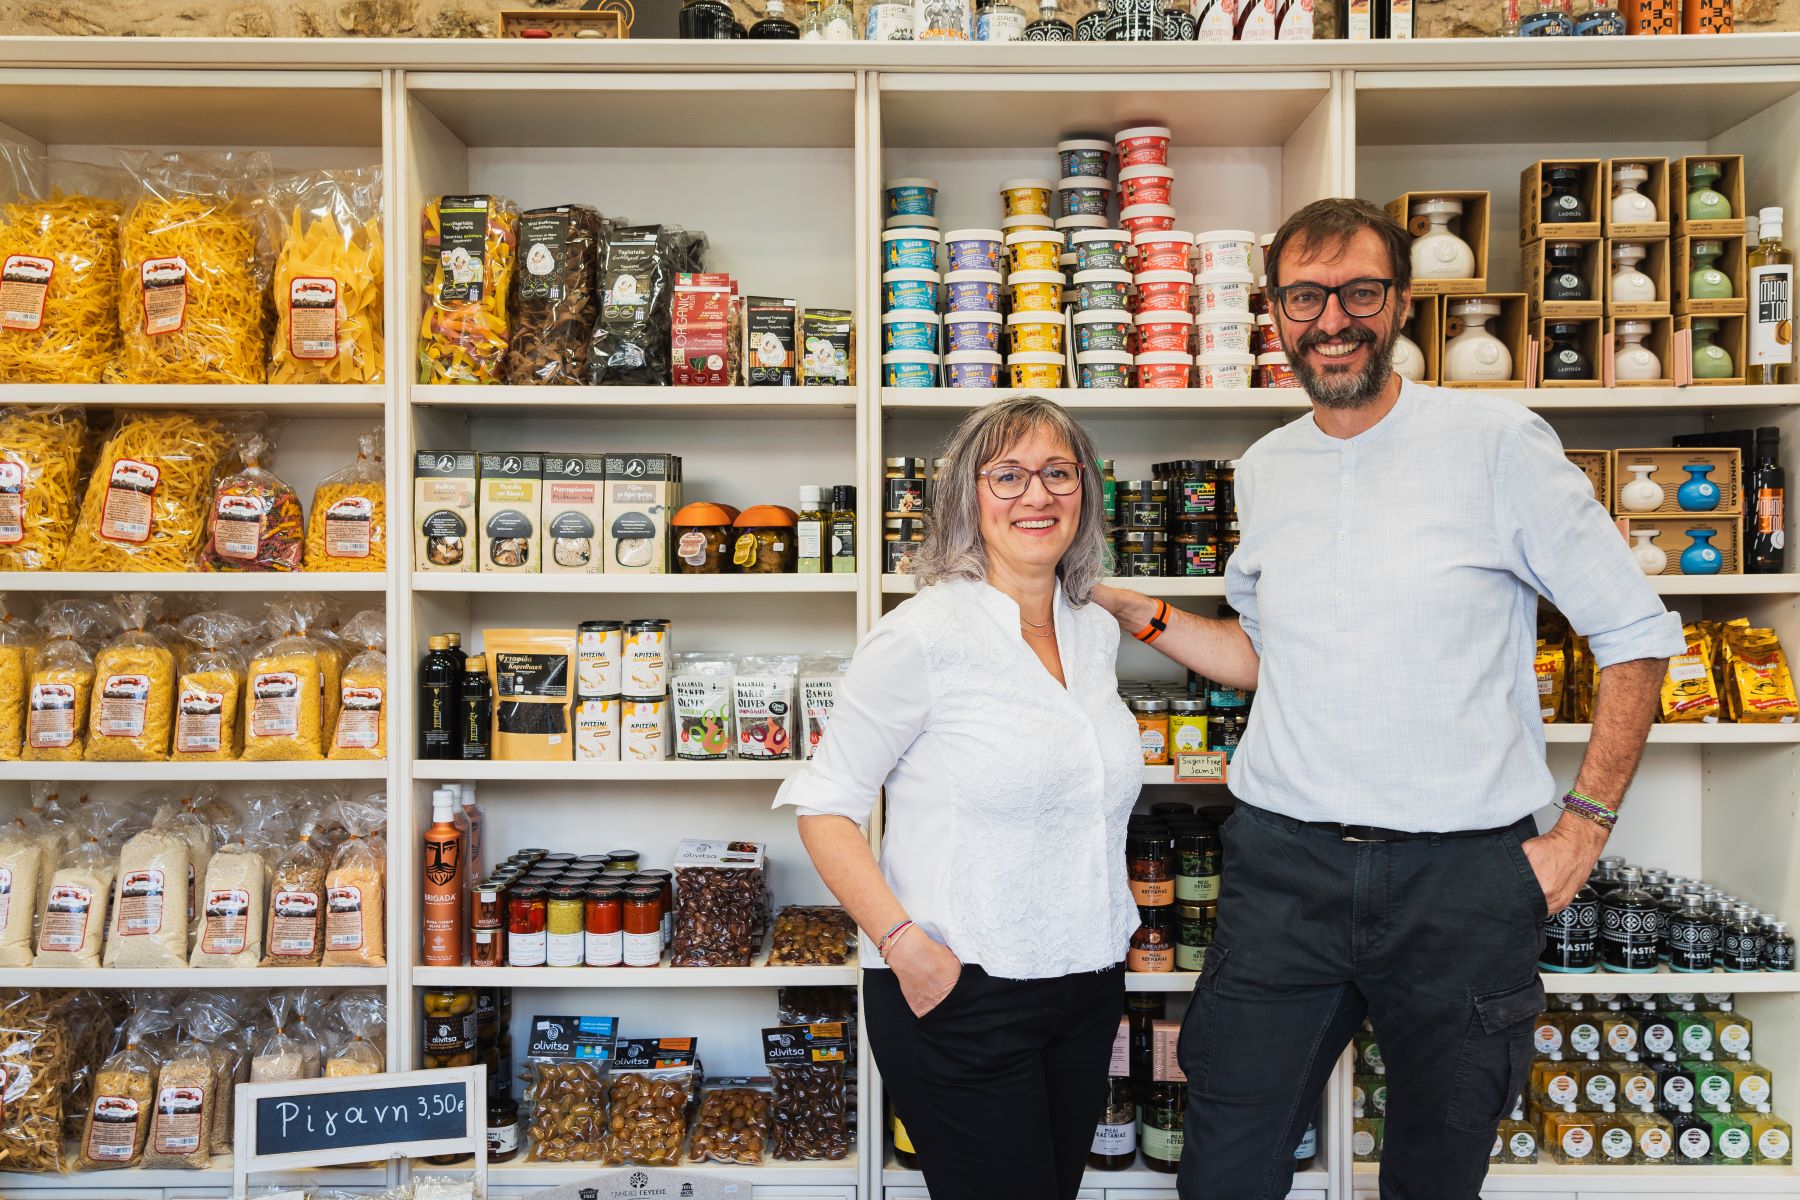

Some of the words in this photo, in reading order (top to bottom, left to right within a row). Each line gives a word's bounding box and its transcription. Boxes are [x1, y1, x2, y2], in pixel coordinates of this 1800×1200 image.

[1116, 30, 1152, 40] MASTIC
[675, 295, 688, 347] ORGANIC
[677, 688, 705, 697] BAKED
[737, 689, 764, 698] BAKED
[806, 689, 833, 698] BAKED
[678, 697, 705, 707] OLIVES
[738, 698, 766, 708] OLIVES
[806, 698, 834, 708] OLIVES
[1182, 756, 1204, 766] Sugar
[1206, 756, 1221, 766] Free
[424, 894, 456, 902] BRIGADA
[1556, 942, 1595, 952] MASTIC
[1622, 945, 1656, 955] MASTIC
[1683, 952, 1712, 960] MASTIC
[432, 1036, 457, 1044] olivitsa
[533, 1040, 570, 1052] olivitsa
[768, 1048, 805, 1057] olivitsa
[614, 1058, 649, 1066] olivitsa
[417, 1093, 465, 1120] 3,50€
[639, 1188, 667, 1196] ΓΕΥΣΕΙΣ
